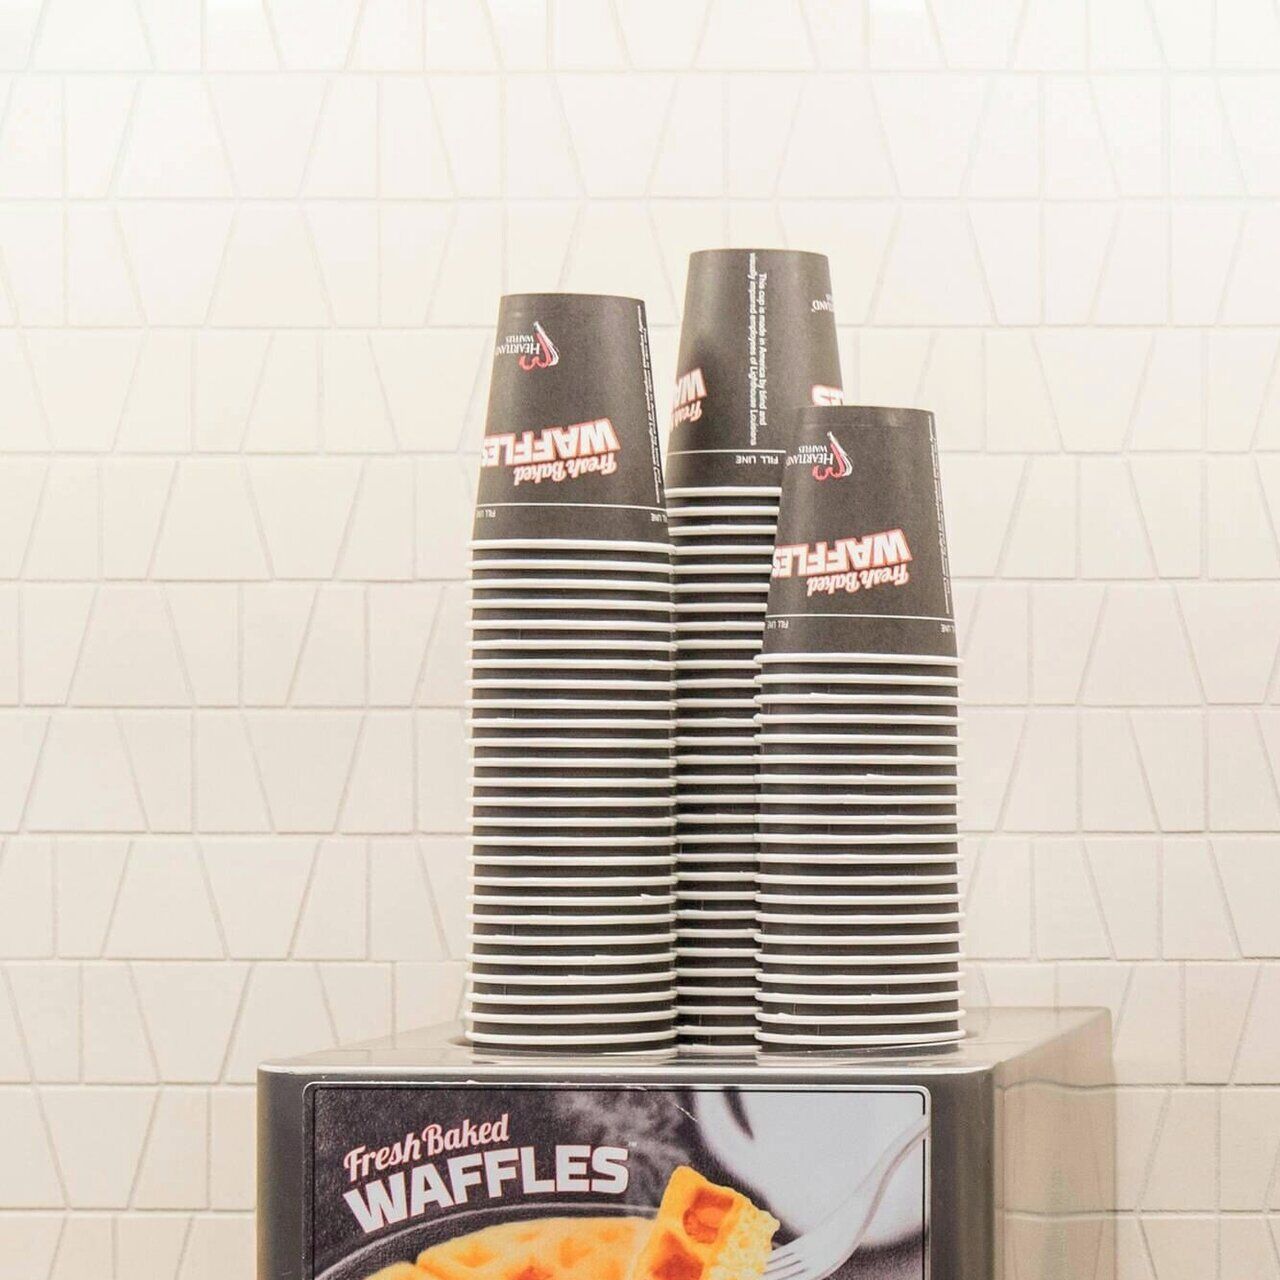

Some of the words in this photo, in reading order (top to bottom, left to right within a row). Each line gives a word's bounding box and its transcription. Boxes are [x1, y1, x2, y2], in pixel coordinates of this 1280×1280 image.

[758, 273, 767, 289] This
[756, 290, 767, 305] cup
[758, 315, 767, 336] made
[758, 346, 767, 378] America
[748, 366, 758, 408] Lighthouse
[757, 379, 767, 389] by
[758, 390, 768, 409] blind
[758, 410, 768, 426] and
[567, 452, 618, 478] Fresh
[736, 454, 757, 465] LINE
[762, 455, 779, 465] FILL
[513, 458, 569, 486] Baked
[806, 571, 861, 597] Baked
[859, 563, 910, 590] Fresh
[343, 1132, 421, 1182] Fresh
[422, 1113, 509, 1157] Baked
[343, 1144, 629, 1234] WAFFLES
